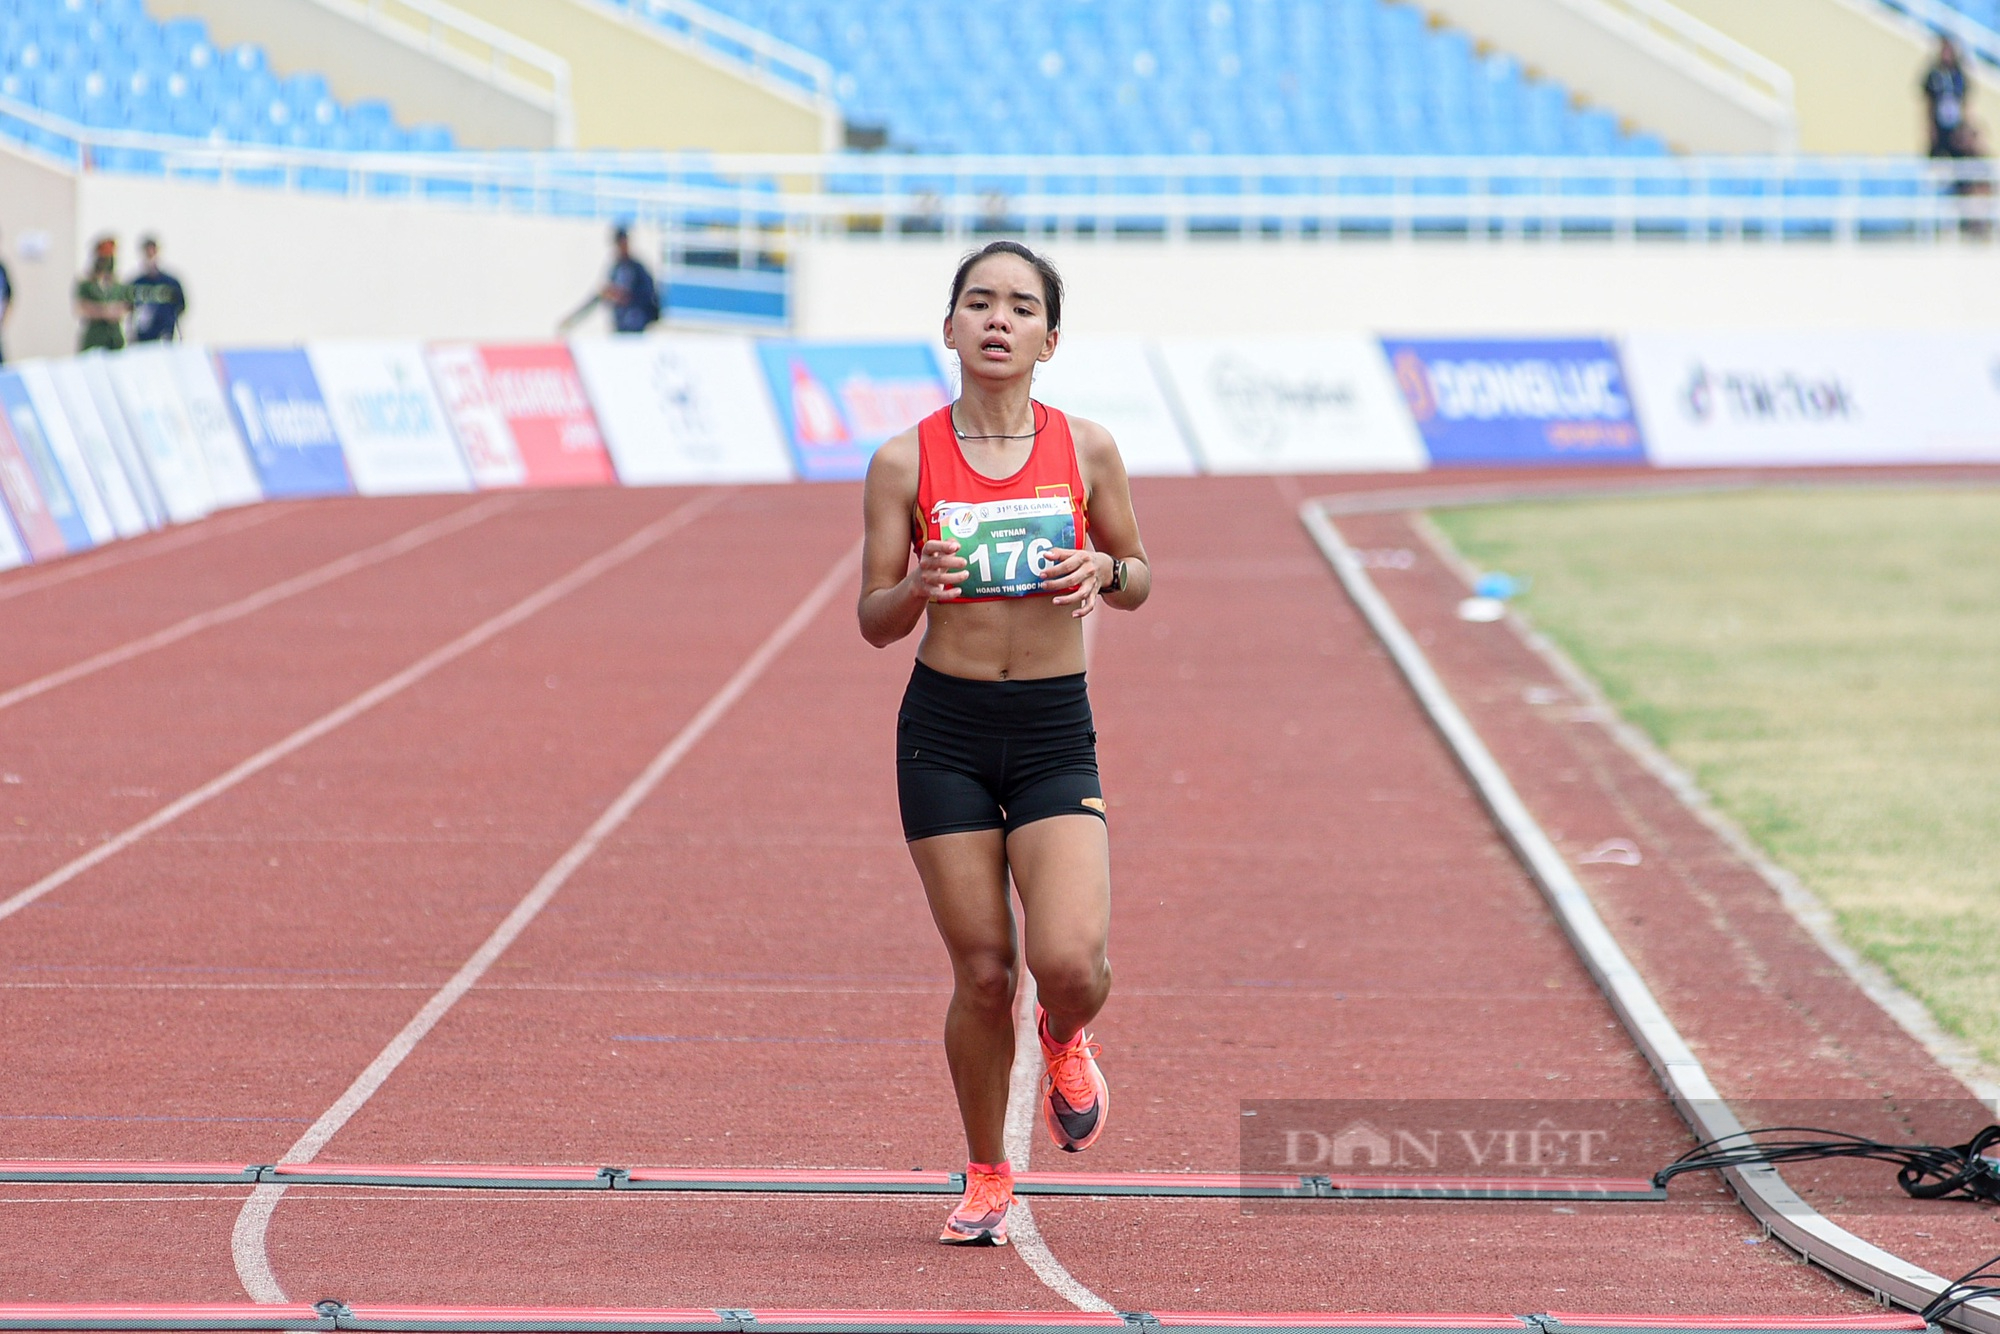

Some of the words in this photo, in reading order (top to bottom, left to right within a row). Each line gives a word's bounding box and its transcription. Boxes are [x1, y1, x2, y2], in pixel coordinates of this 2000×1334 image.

[1013, 503, 1030, 512] SEA
[1030, 501, 1059, 511] GAMES
[990, 527, 1027, 538] VIETNAM
[968, 537, 1056, 583] 176
[975, 586, 1001, 595] HOANG
[1001, 584, 1015, 593] THI
[1016, 582, 1037, 592] NGOC
